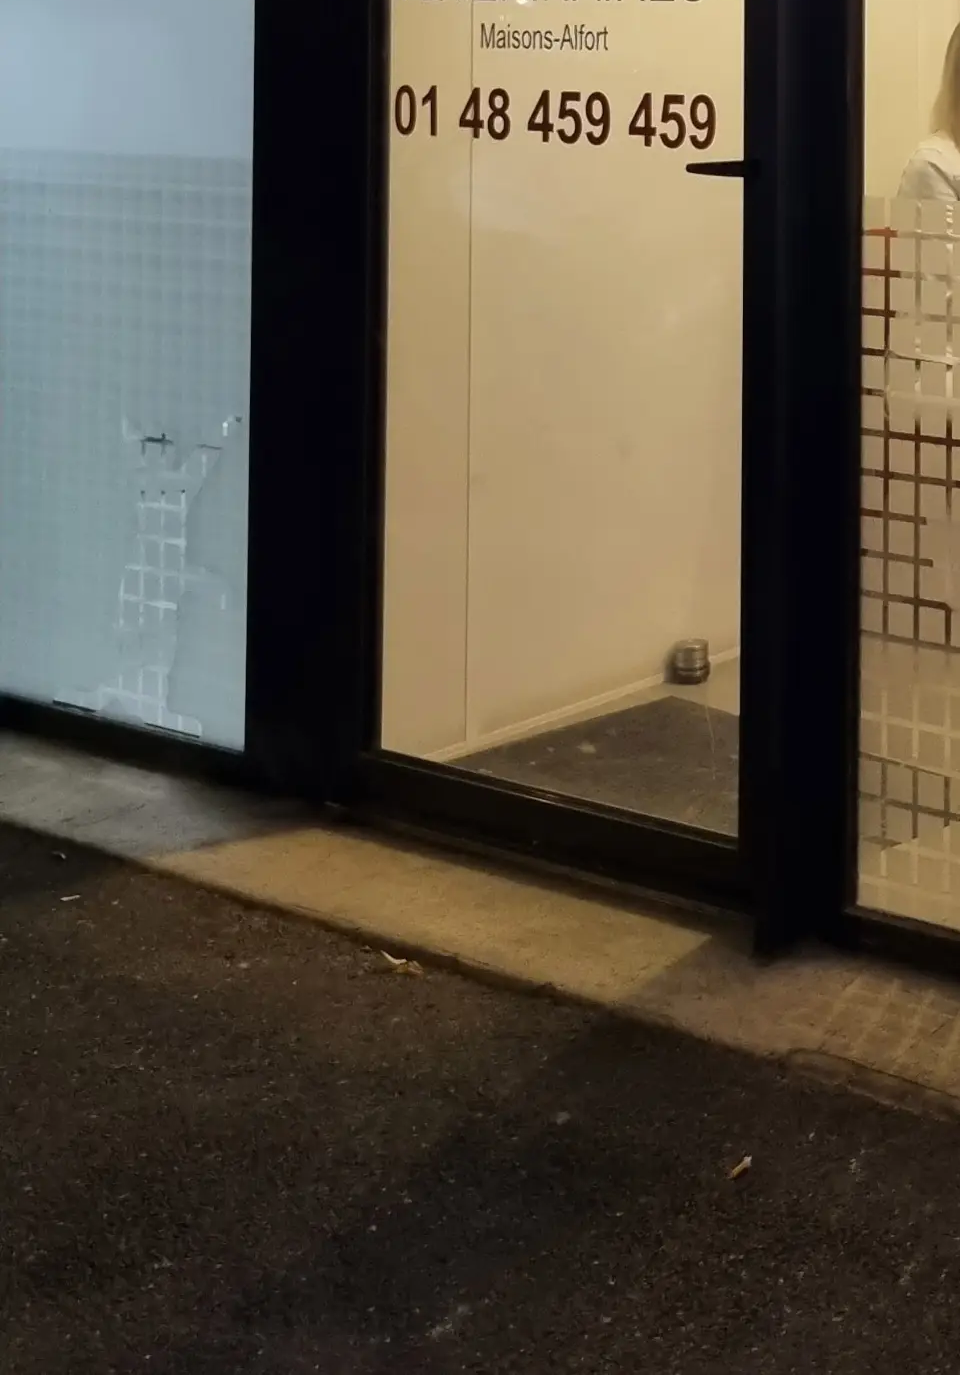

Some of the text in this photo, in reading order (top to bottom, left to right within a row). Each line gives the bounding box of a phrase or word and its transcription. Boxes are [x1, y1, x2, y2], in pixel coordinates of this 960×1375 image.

[480, 23, 609, 52] Maisons-Alfort
[394, 84, 716, 150] 01 48 459 459
